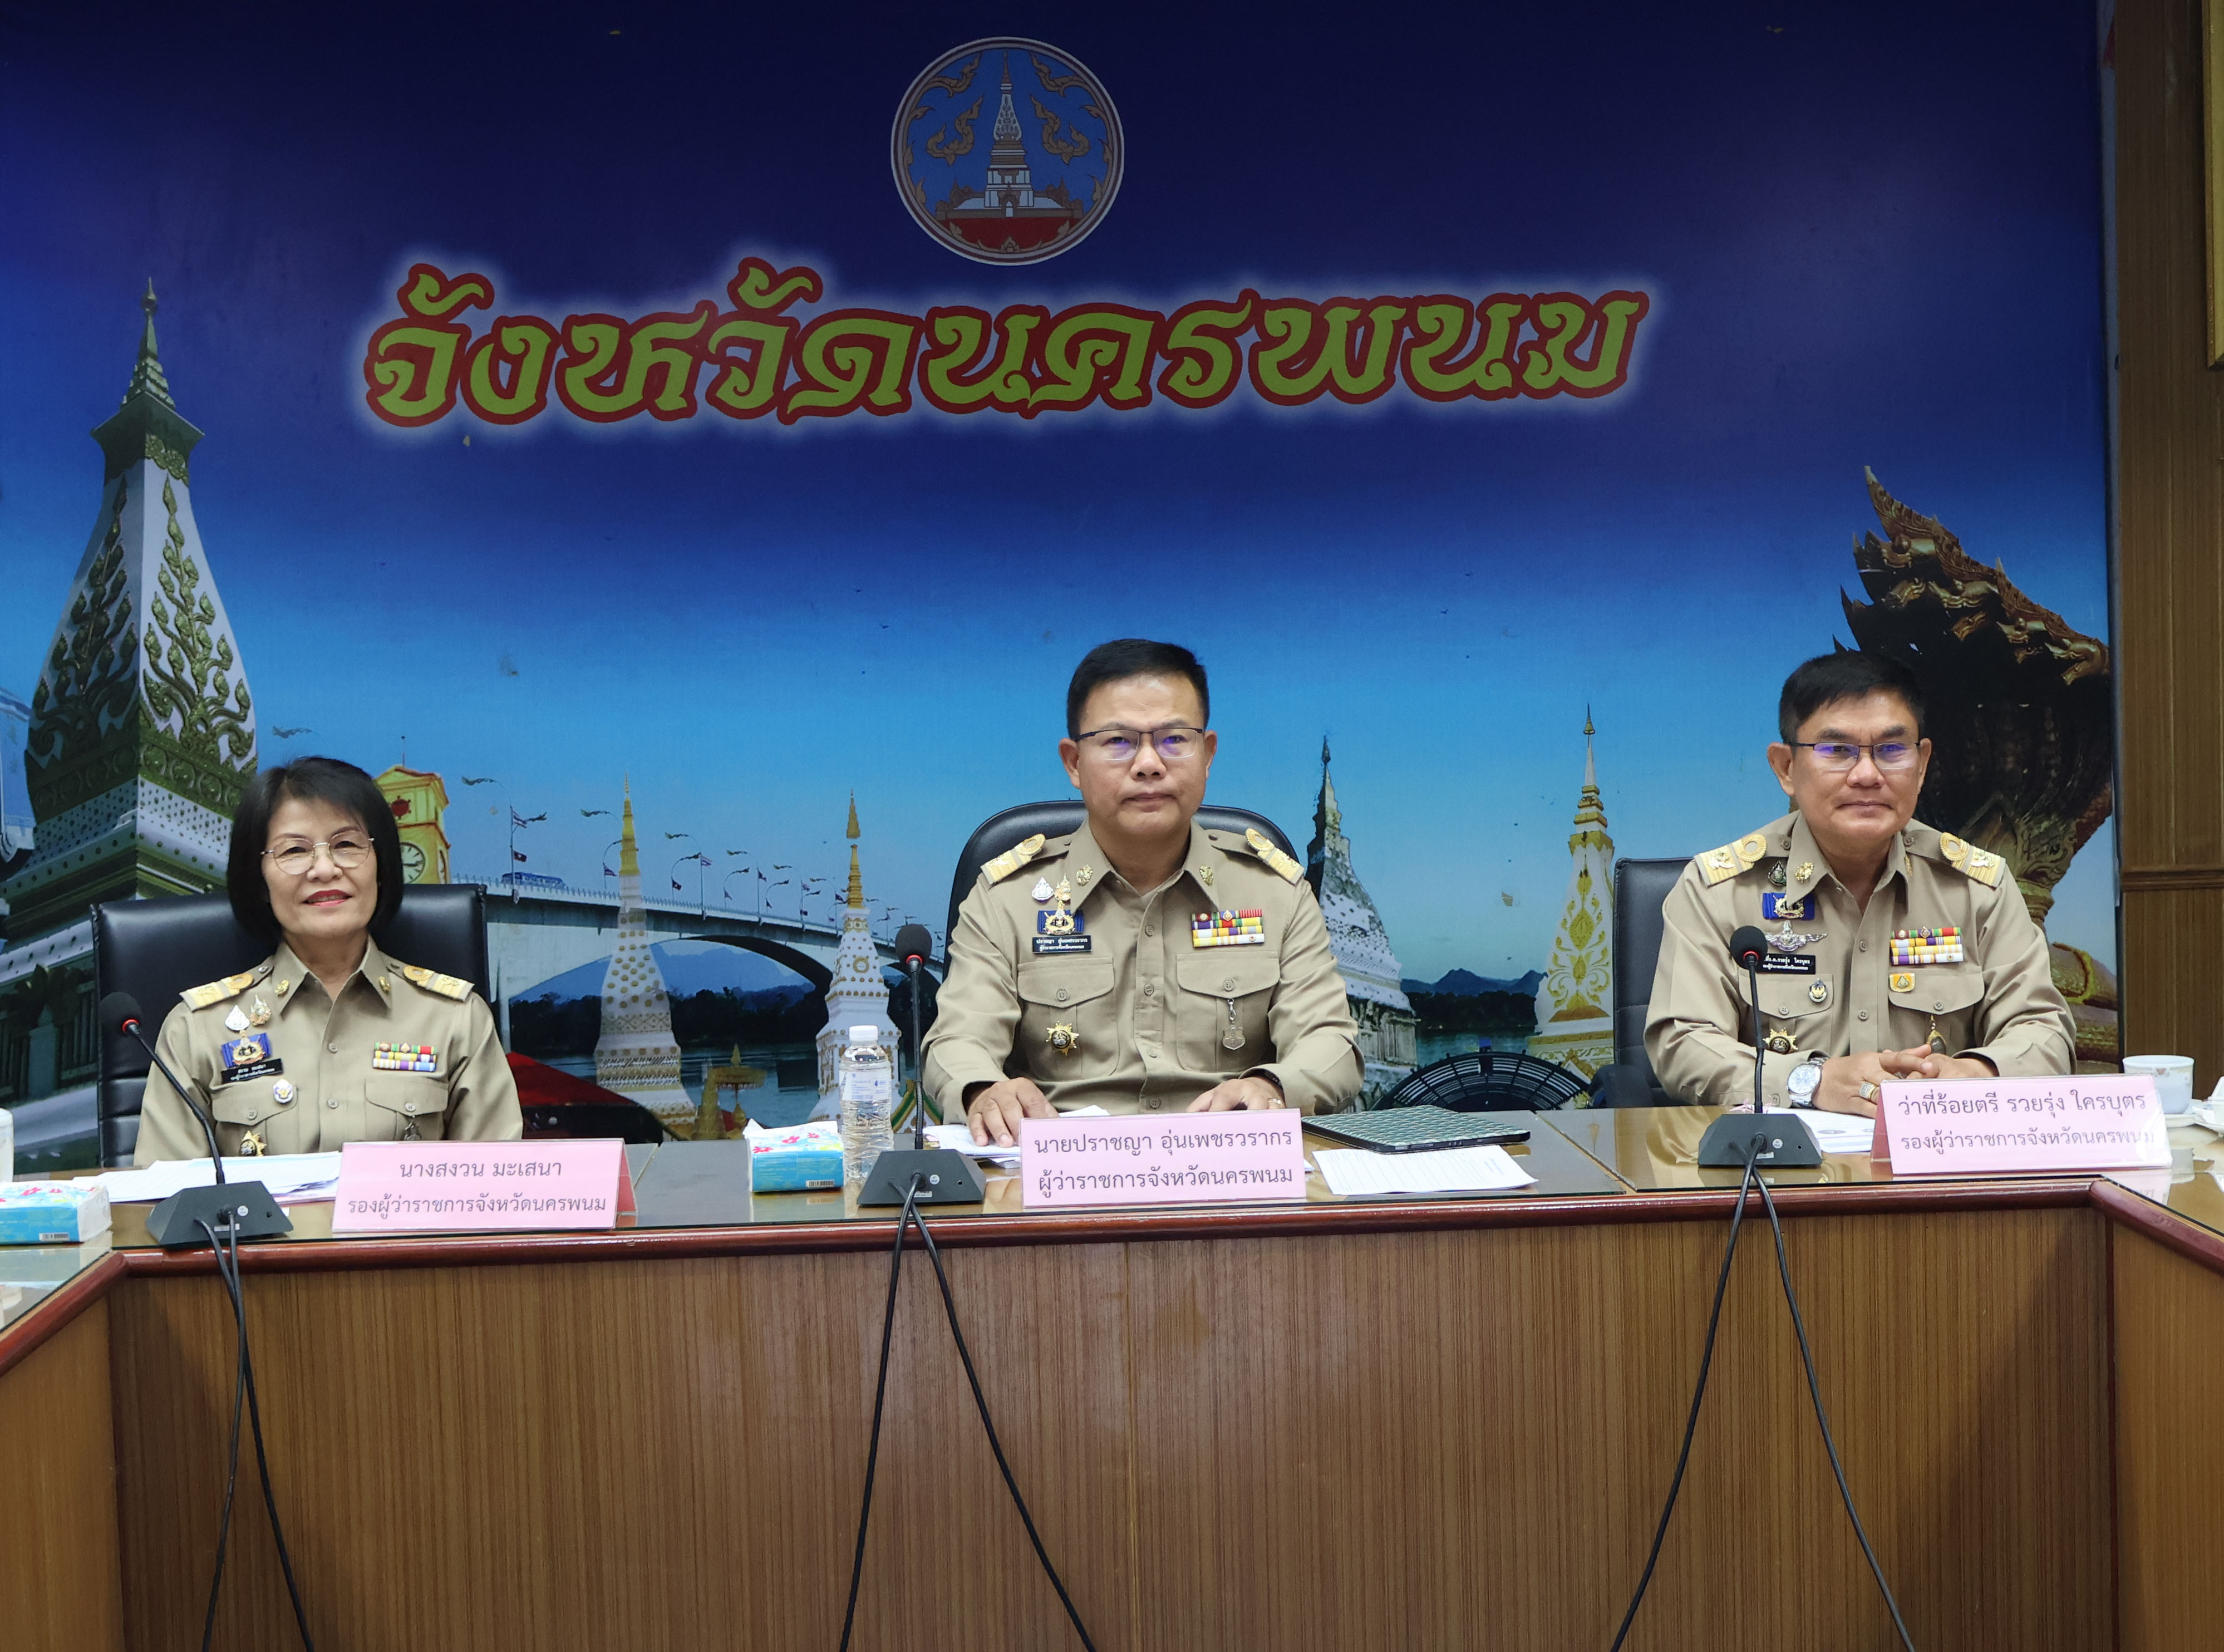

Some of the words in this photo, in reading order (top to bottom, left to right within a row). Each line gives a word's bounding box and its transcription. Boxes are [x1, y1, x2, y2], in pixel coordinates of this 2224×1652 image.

[365, 258, 1649, 426] จังหวัดนครพนม
[1898, 1089, 1999, 1116] ว่าที่ร้อยตรี
[2006, 1092, 2065, 1119] รวยรุ่ง
[2069, 1089, 2147, 1118] ใครบุตร
[1034, 1133, 1152, 1157] นายปราชญา
[1161, 1129, 1293, 1156] อุ่นเพชรวรากร
[400, 1162, 485, 1178] นางสงวน
[492, 1161, 562, 1177] มะเสนา
[1039, 1164, 1293, 1198] ผู้ว่าราชการจังหวัดนครพนม
[348, 1192, 607, 1220] รองผู้ว่าราชการจังหวัดนครพนม
